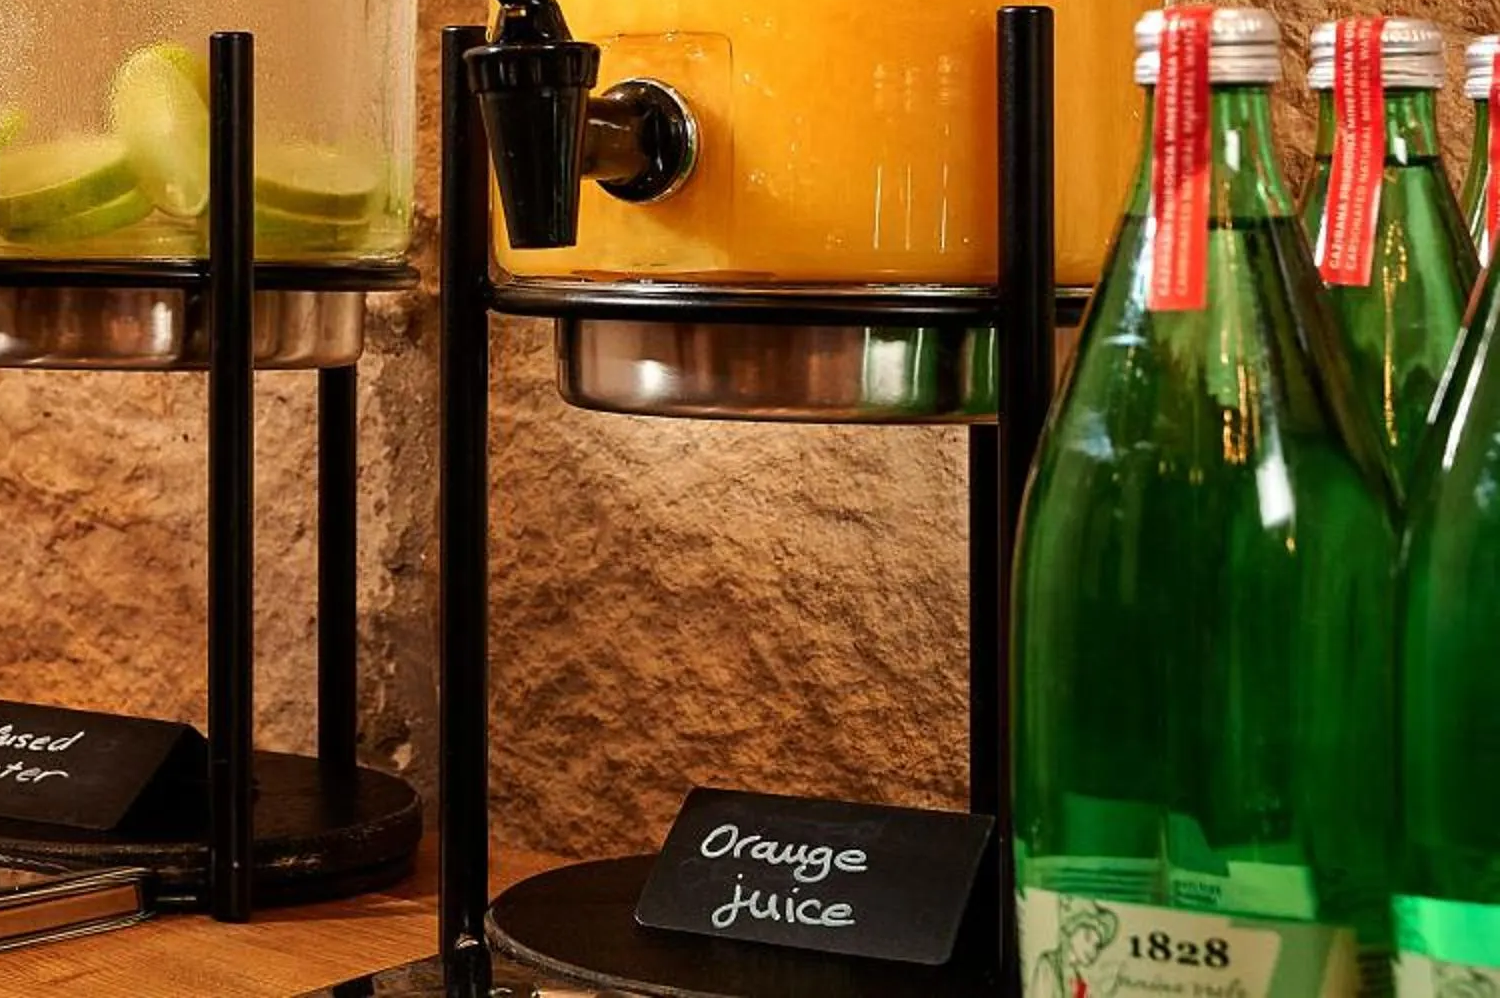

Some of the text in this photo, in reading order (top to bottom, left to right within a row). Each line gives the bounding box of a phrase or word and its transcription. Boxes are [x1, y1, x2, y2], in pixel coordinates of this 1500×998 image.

[701, 824, 868, 882] Orange
[711, 873, 856, 928] juice
[1128, 931, 1231, 969] 1828
